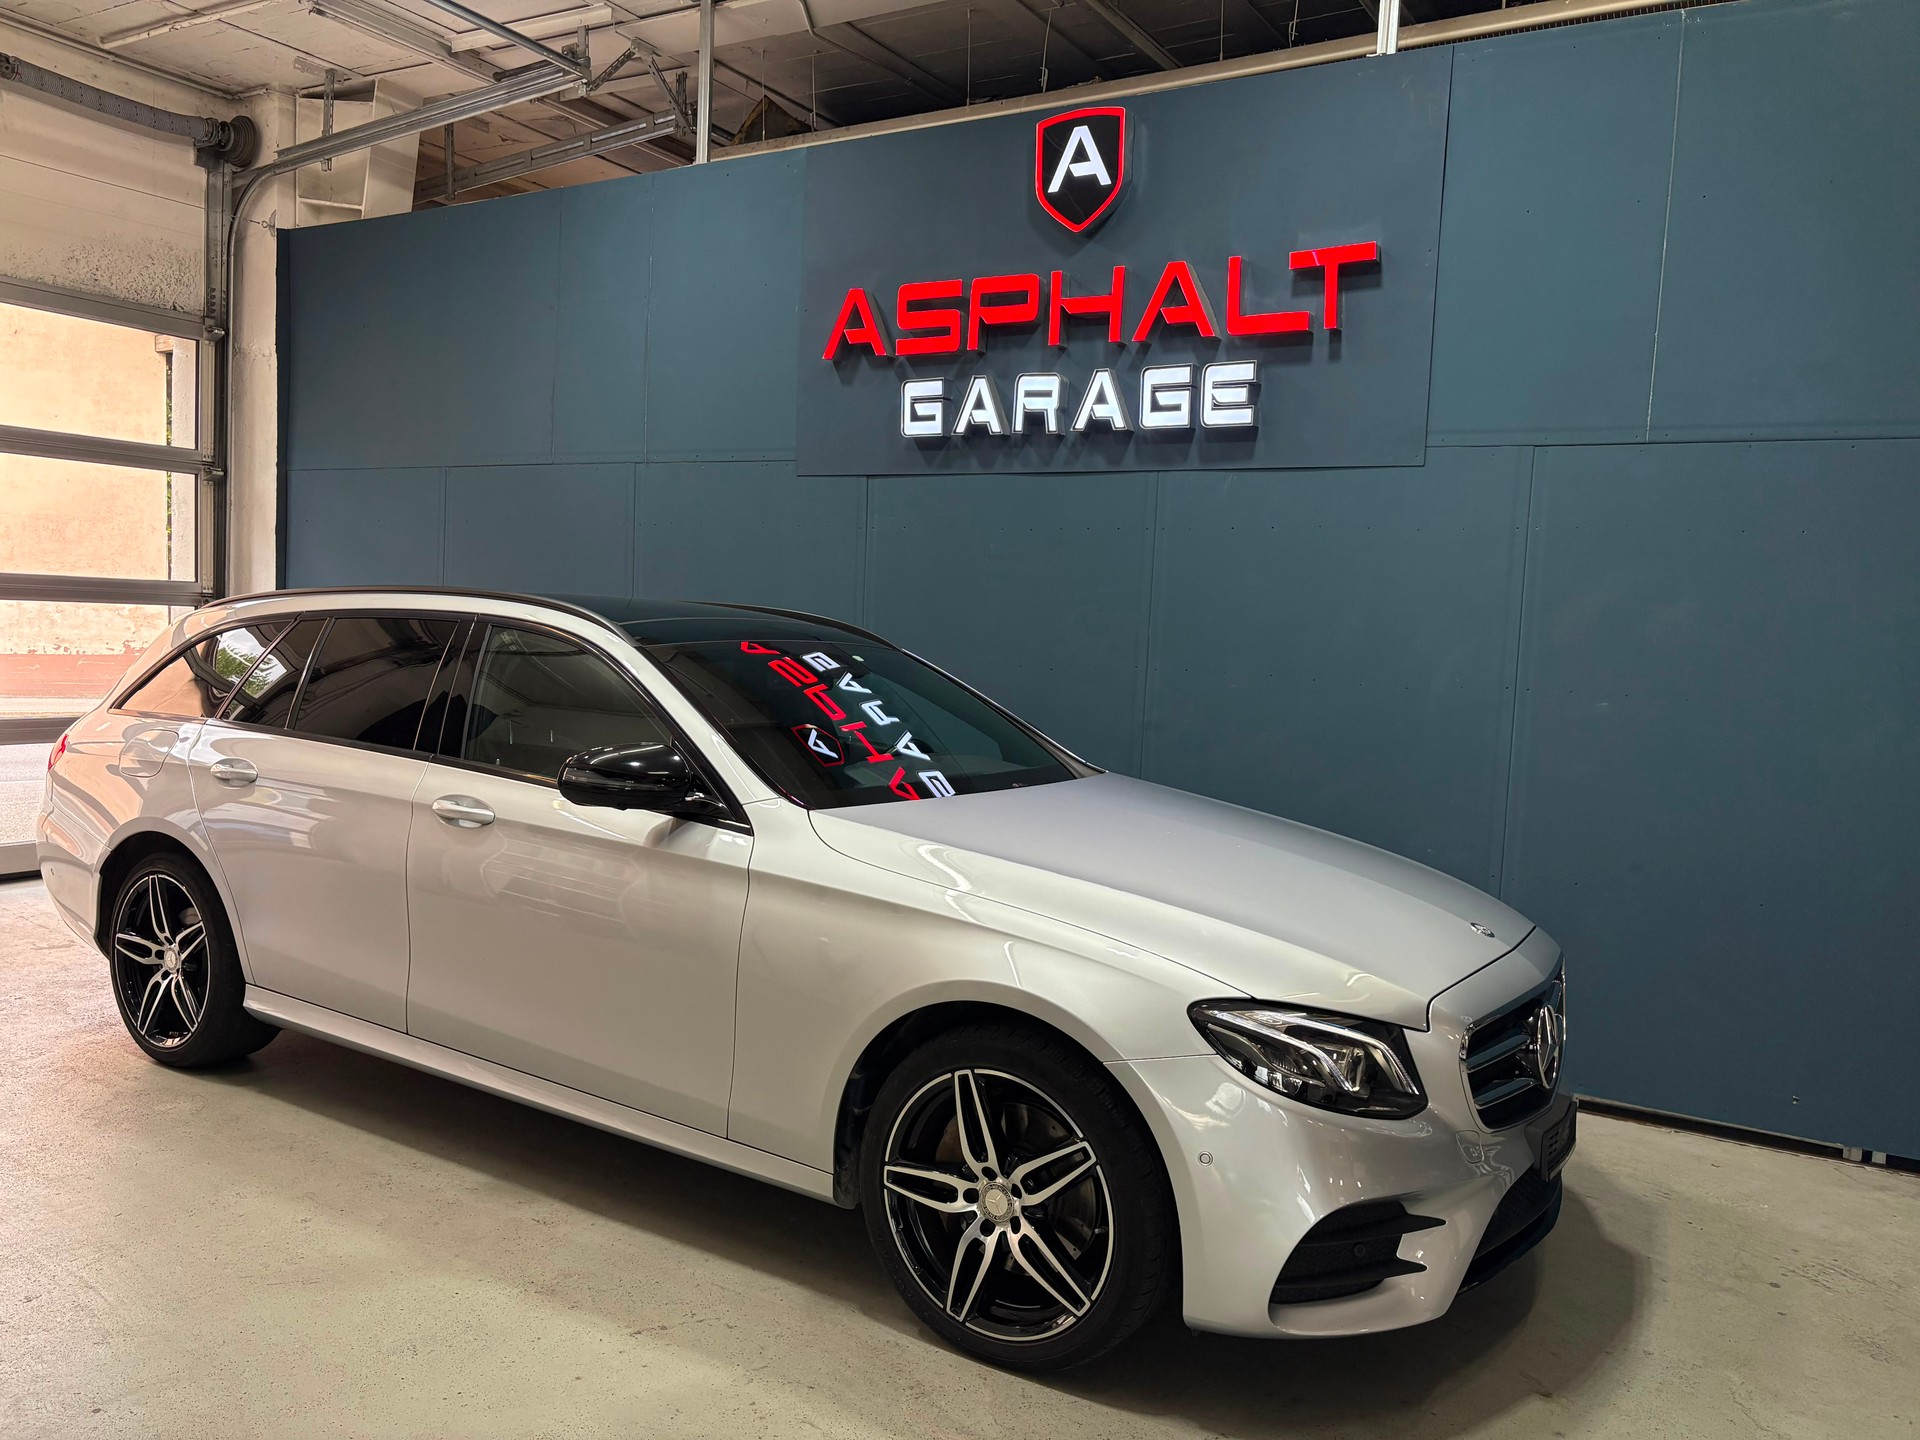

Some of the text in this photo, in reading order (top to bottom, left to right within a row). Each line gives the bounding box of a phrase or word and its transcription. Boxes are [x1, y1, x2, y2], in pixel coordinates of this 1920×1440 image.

[1047, 125, 1112, 193] A
[822, 241, 1379, 360] ASPHALT
[900, 360, 1260, 437] GARAGE
